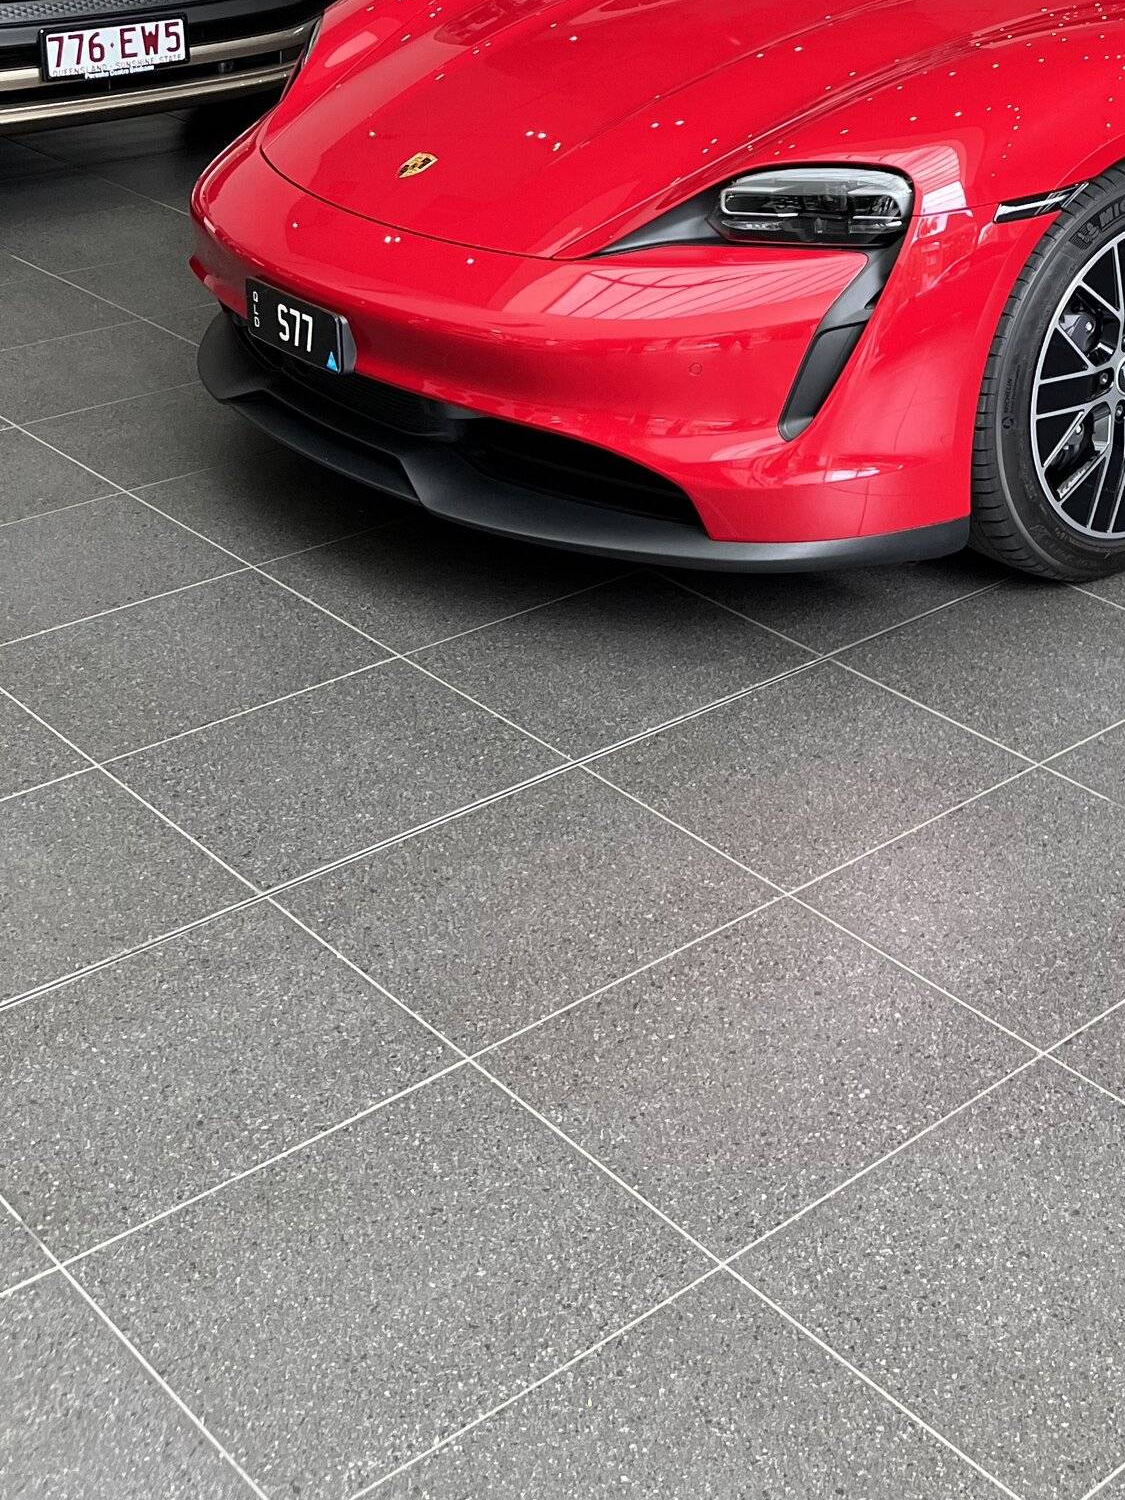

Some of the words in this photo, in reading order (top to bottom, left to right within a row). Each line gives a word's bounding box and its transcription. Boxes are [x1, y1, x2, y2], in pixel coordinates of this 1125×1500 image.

[48, 32, 106, 68] 776
[119, 21, 181, 59] EW5
[52, 63, 107, 77] QUEENSLAND
[115, 57, 154, 69] SUNSHINE
[159, 53, 181, 63] STATE
[277, 303, 313, 353] S77
